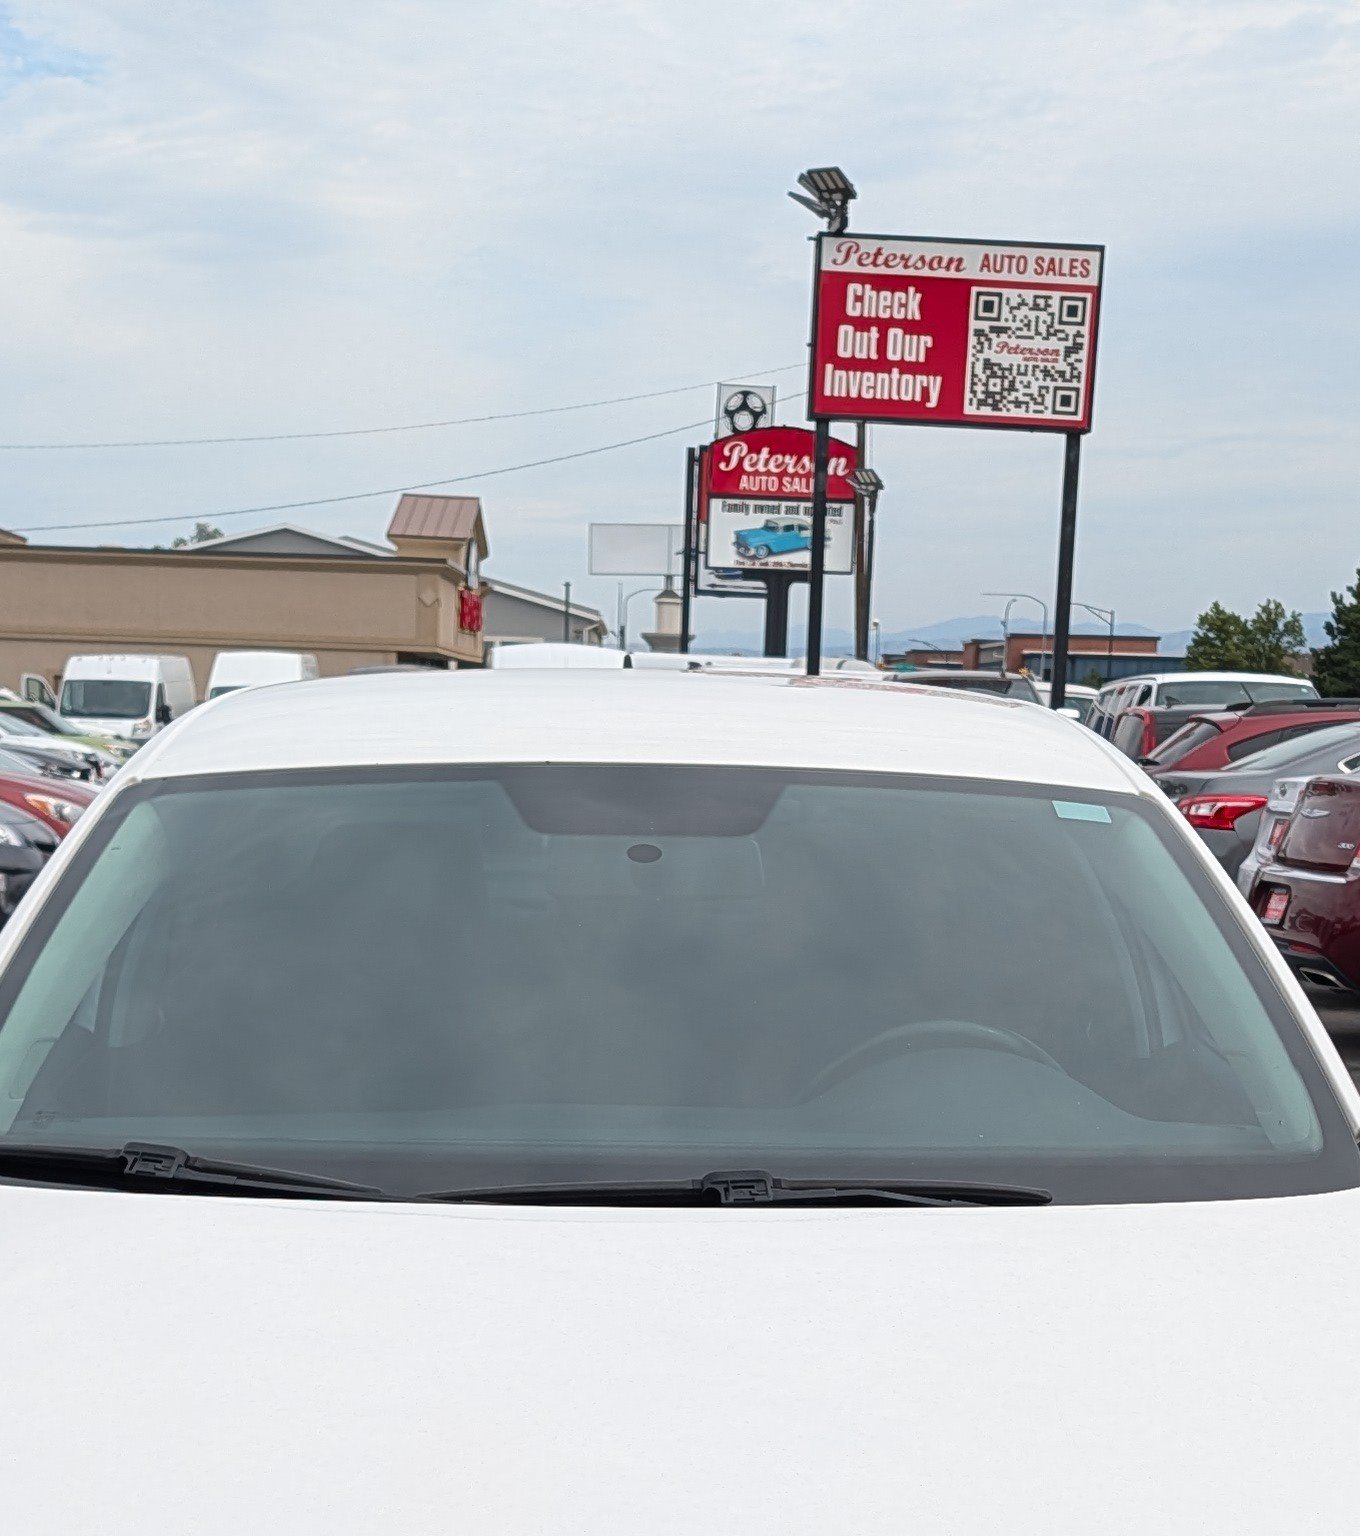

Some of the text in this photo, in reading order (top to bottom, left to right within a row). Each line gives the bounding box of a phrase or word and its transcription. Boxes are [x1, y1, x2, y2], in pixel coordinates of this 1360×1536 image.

[831, 240, 1090, 279] Peterson AUTO SALES
[845, 282, 922, 320] Check
[836, 324, 933, 363] Out Our
[823, 363, 942, 409] Inventory
[718, 441, 850, 476] Petersn
[739, 475, 814, 493] AUTO SAL
